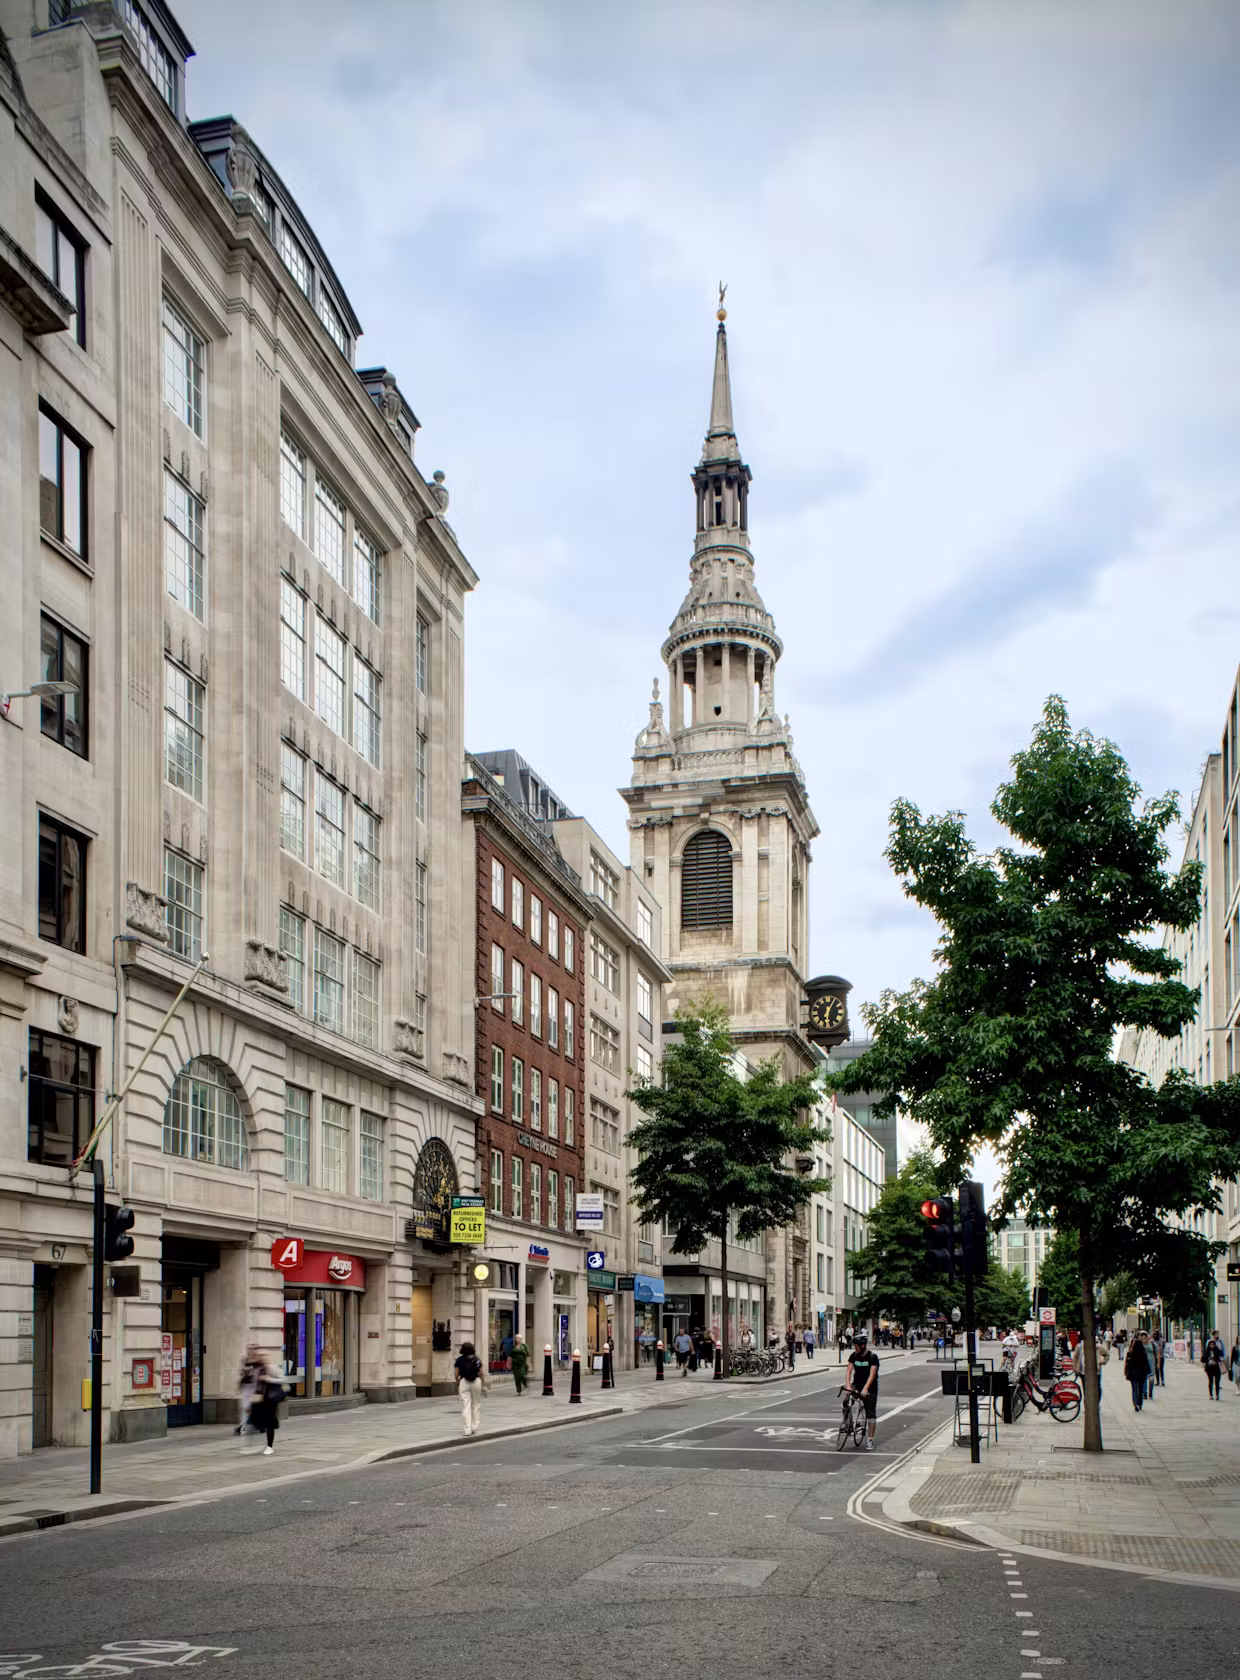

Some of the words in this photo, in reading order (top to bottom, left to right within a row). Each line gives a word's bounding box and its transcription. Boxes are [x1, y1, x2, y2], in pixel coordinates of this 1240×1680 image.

[540, 1140, 557, 1159] HOUSE
[454, 1223, 466, 1231] TO
[469, 1223, 482, 1231] LET
[52, 1244, 67, 1260] 67
[279, 1241, 297, 1262] A
[329, 1256, 352, 1274] Argos
